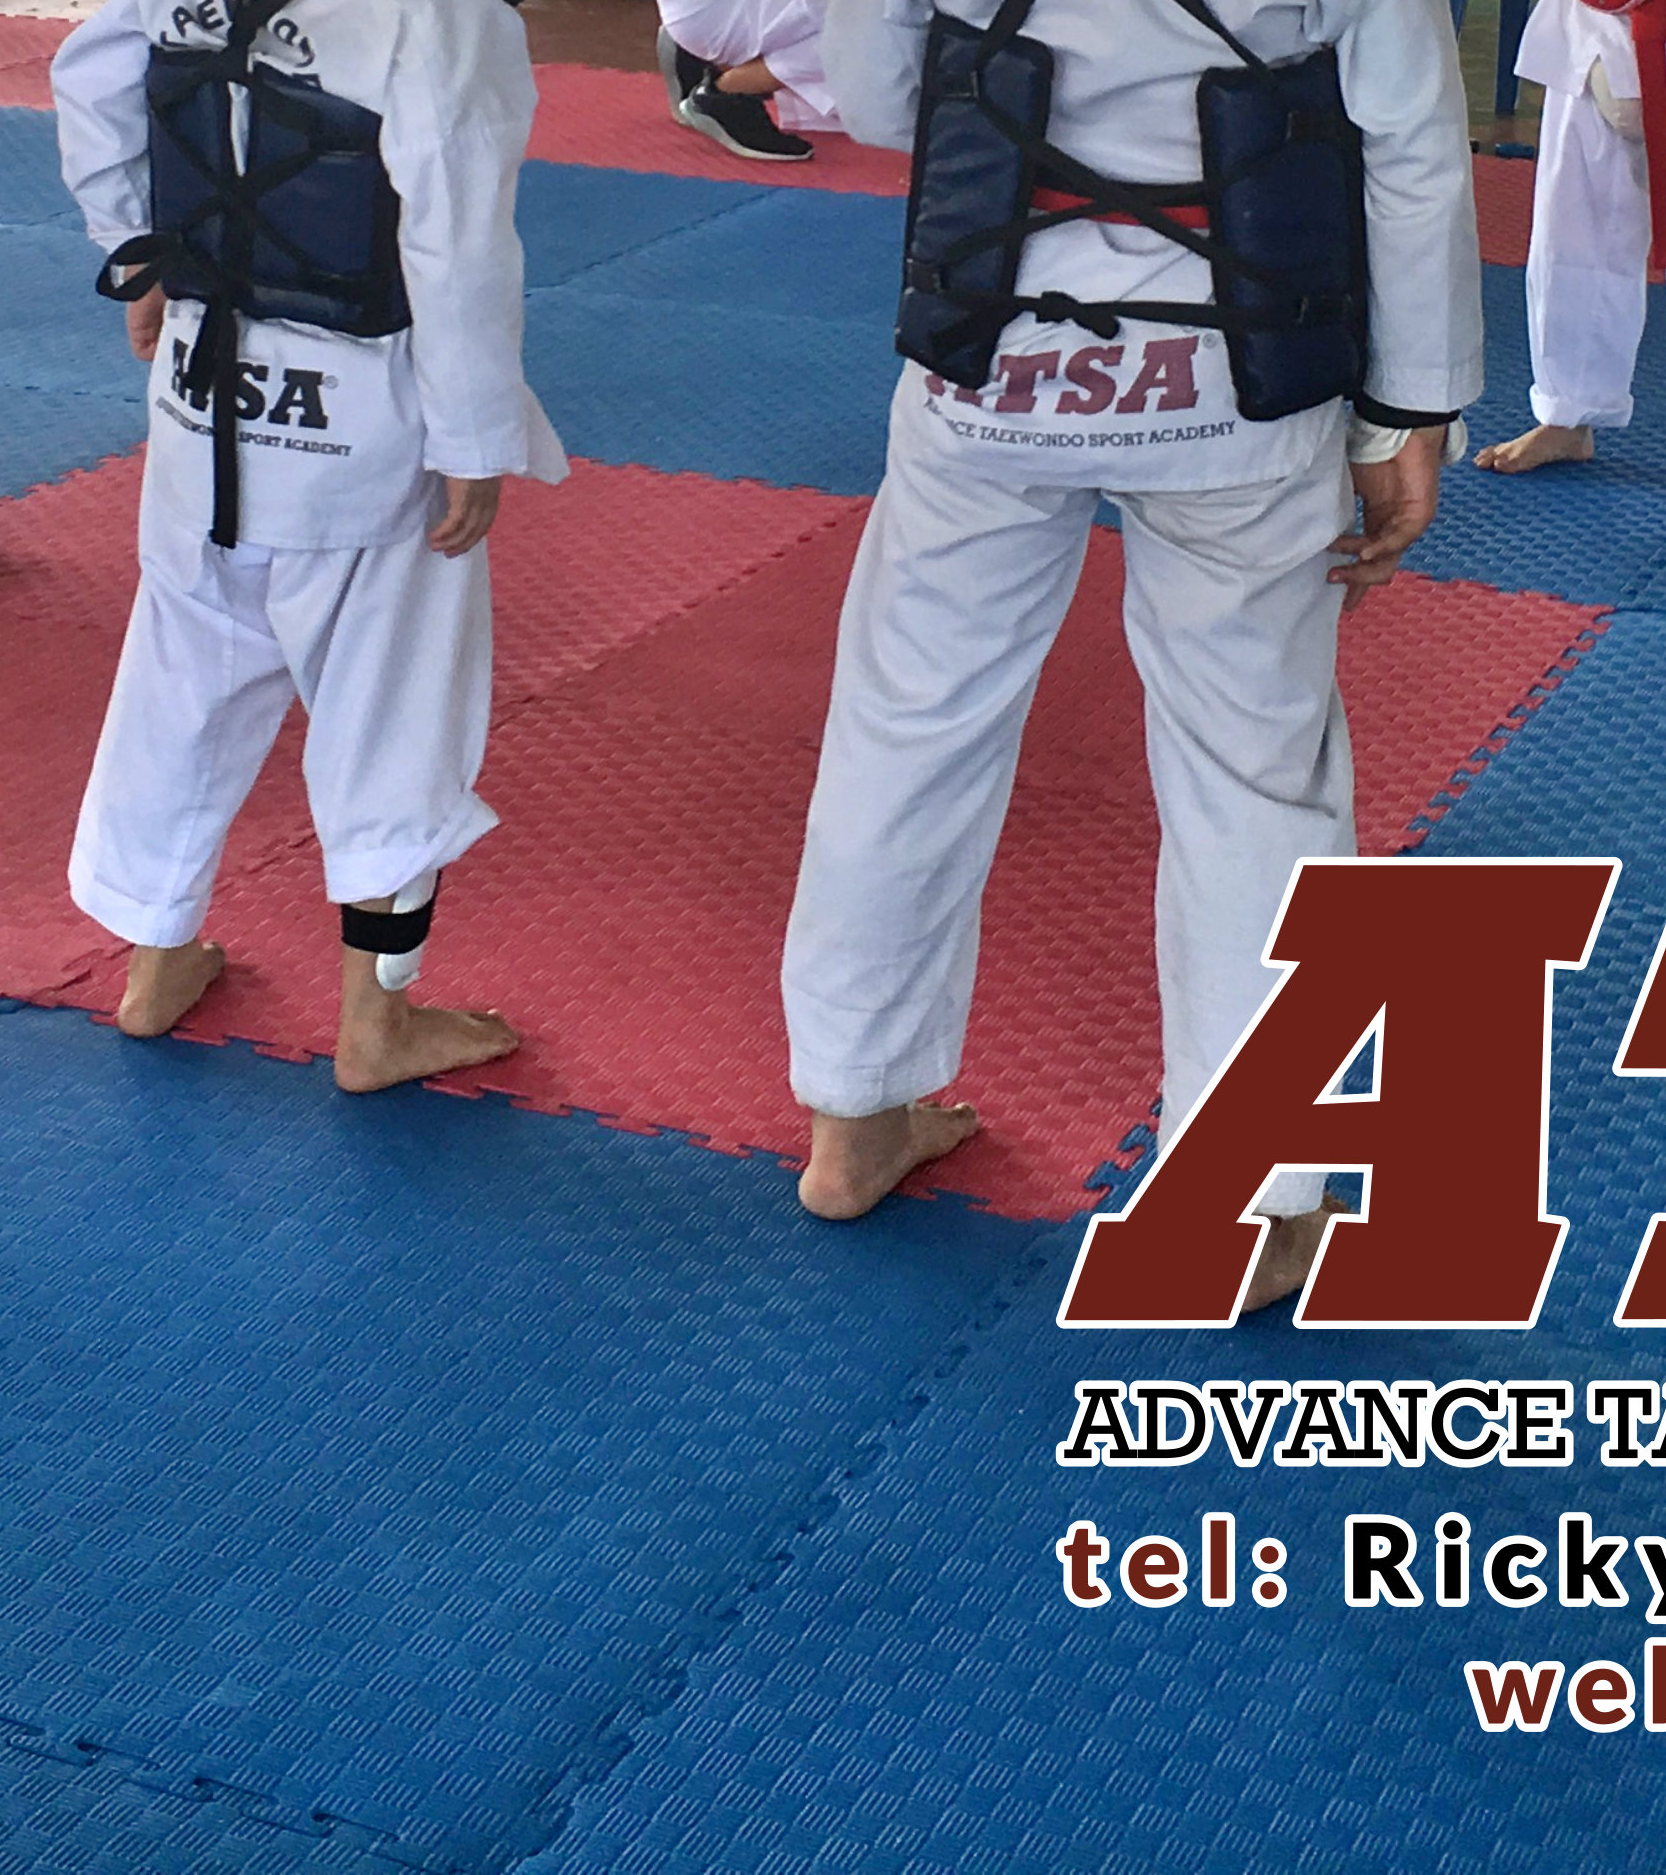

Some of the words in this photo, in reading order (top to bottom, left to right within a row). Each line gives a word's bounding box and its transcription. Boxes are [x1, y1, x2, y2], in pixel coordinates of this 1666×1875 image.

[238, 431, 282, 450] SPORT
[284, 438, 353, 457] ACADEMY
[979, 426, 1084, 448] TAEKWONDO
[1087, 431, 1144, 448] SPORT
[1148, 421, 1236, 444] ACADEMY
